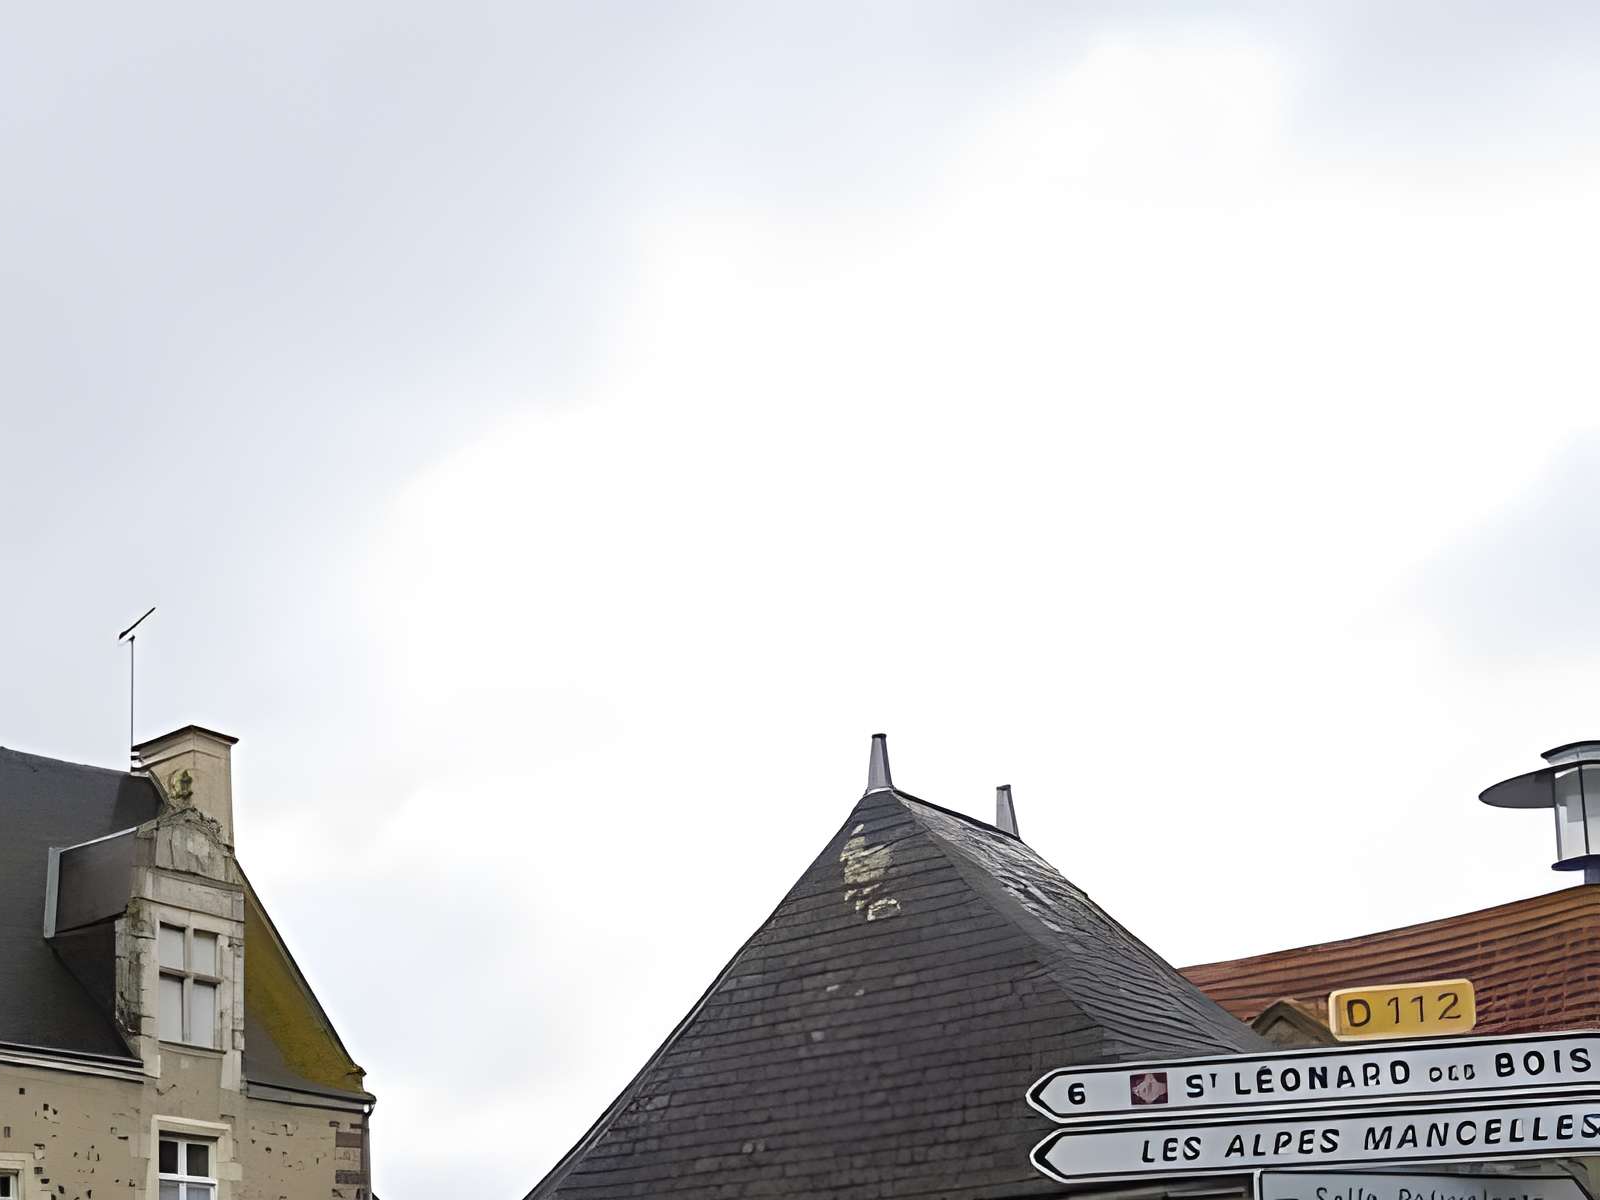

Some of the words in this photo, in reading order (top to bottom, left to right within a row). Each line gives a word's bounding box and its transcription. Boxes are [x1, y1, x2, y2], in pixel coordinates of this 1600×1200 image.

[1346, 998, 1371, 1028] D
[1387, 992, 1462, 1025] 112
[1067, 1082, 1086, 1105] 6
[1234, 1059, 1410, 1096] LÉONARD
[1495, 1047, 1592, 1078] BOIS
[1142, 1136, 1202, 1163] LES
[1224, 1128, 1340, 1158] ALPES
[1364, 1113, 1600, 1152] MANCELLES
